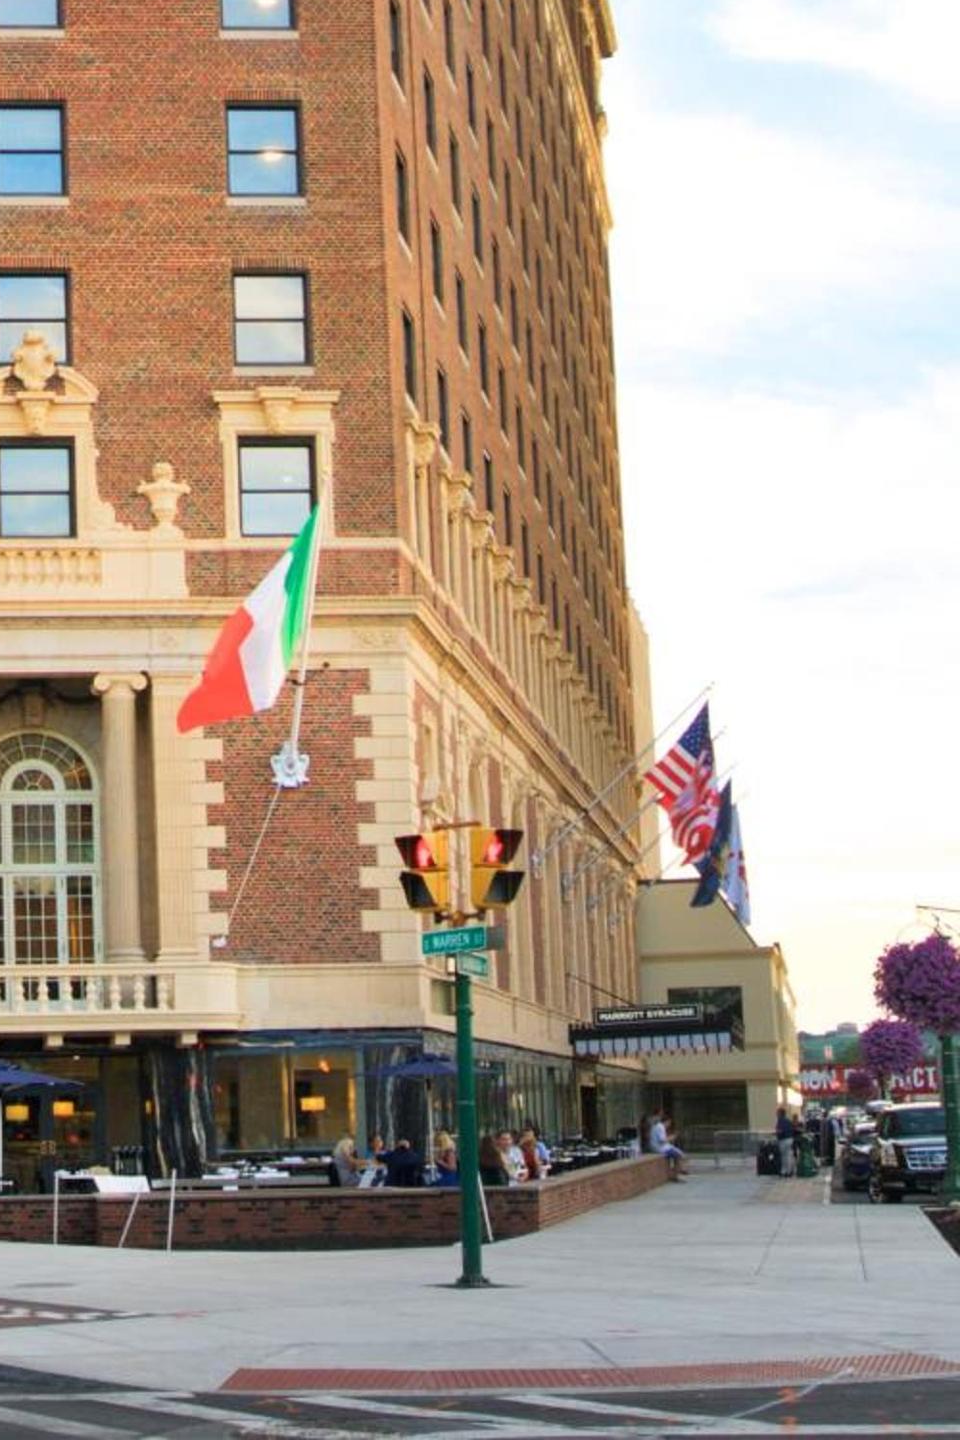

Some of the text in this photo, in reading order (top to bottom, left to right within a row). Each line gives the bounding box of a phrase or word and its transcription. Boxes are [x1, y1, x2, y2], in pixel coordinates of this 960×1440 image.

[433, 933, 469, 949] WARREN
[599, 1008, 695, 1021] MARRIOTT SYRACUSE
